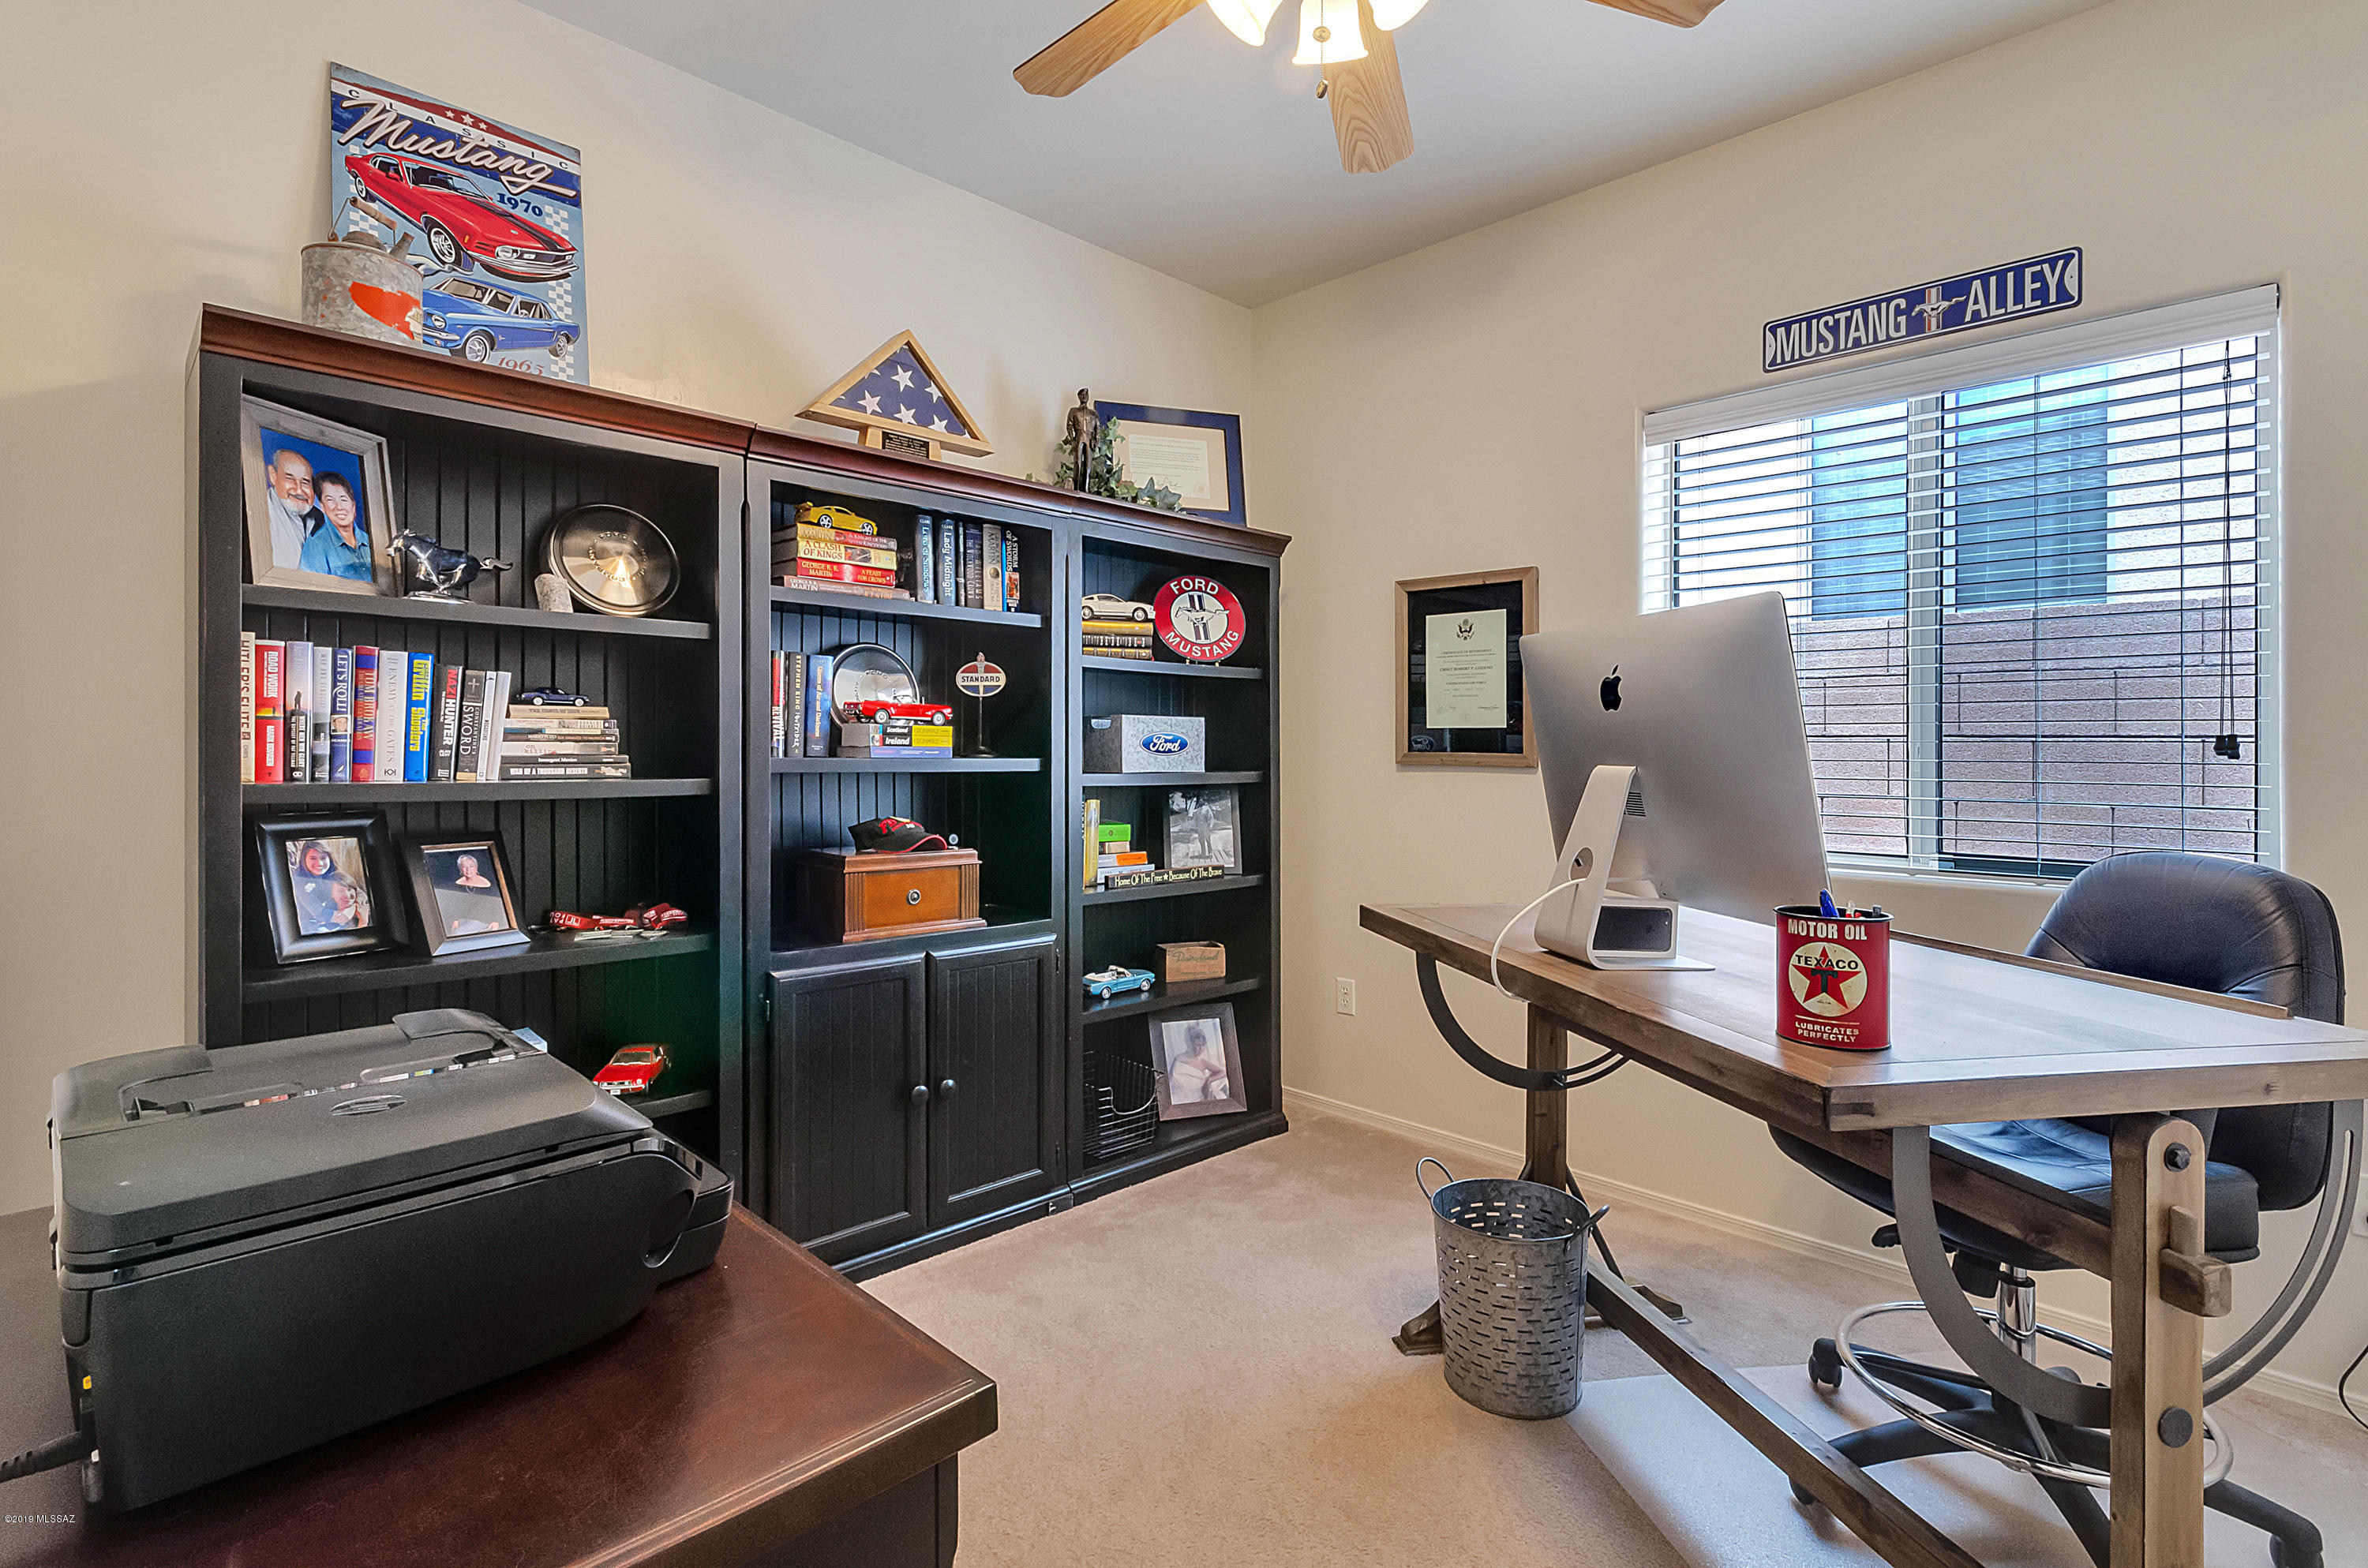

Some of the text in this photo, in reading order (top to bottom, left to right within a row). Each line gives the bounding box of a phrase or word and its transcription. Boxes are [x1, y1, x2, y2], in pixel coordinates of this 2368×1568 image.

[348, 88, 569, 170] CLASSIC
[338, 99, 578, 198] Mustang
[496, 193, 543, 218] 1970
[1774, 259, 2066, 364] MUSTANG ALLEY
[497, 355, 545, 377] 1965
[802, 530, 833, 541] MARTIN
[812, 541, 841, 552] CLASH
[1006, 530, 1011, 541] OF
[801, 560, 826, 570] GEORGE
[817, 549, 843, 560] KINGS
[942, 532, 954, 597] Lady Midnight
[791, 582, 819, 592] MARTIN
[1169, 578, 1220, 595] FORD
[1165, 629, 1239, 658] MUSTANG
[268, 651, 279, 698] ROAD WORK
[332, 654, 348, 712] LET'S ROLL!
[388, 668, 397, 702] ENEMY
[412, 659, 430, 700] Griffin
[446, 669, 458, 699] NAZI
[961, 675, 1000, 683] STANDARD
[363, 672, 375, 740] TOM BROKAW
[410, 707, 425, 751] Shooters
[443, 698, 456, 745] HUNTER
[460, 705, 474, 755] SWORD
[772, 706, 785, 739] REVIVAL
[792, 714, 800, 748] OUTSIDER
[386, 730, 395, 762] GATES
[886, 736, 910, 745] Ireland
[1149, 735, 1181, 752] Ford
[1115, 875, 1130, 887] Home
[1130, 874, 1139, 885] Of
[1140, 874, 1150, 885] The
[1150, 872, 1163, 884] Free
[1168, 870, 1190, 881] Because
[1190, 868, 1198, 879] Of
[1197, 868, 1208, 878] The
[1208, 866, 1222, 877] Brave
[1787, 919, 1868, 941] MOTOR OIL
[1795, 954, 1859, 970] TEXACO
[1811, 968, 1838, 993] T
[1795, 1021, 1859, 1035] LUBRICATES
[1797, 1028, 1857, 1042] PERFECTLY
